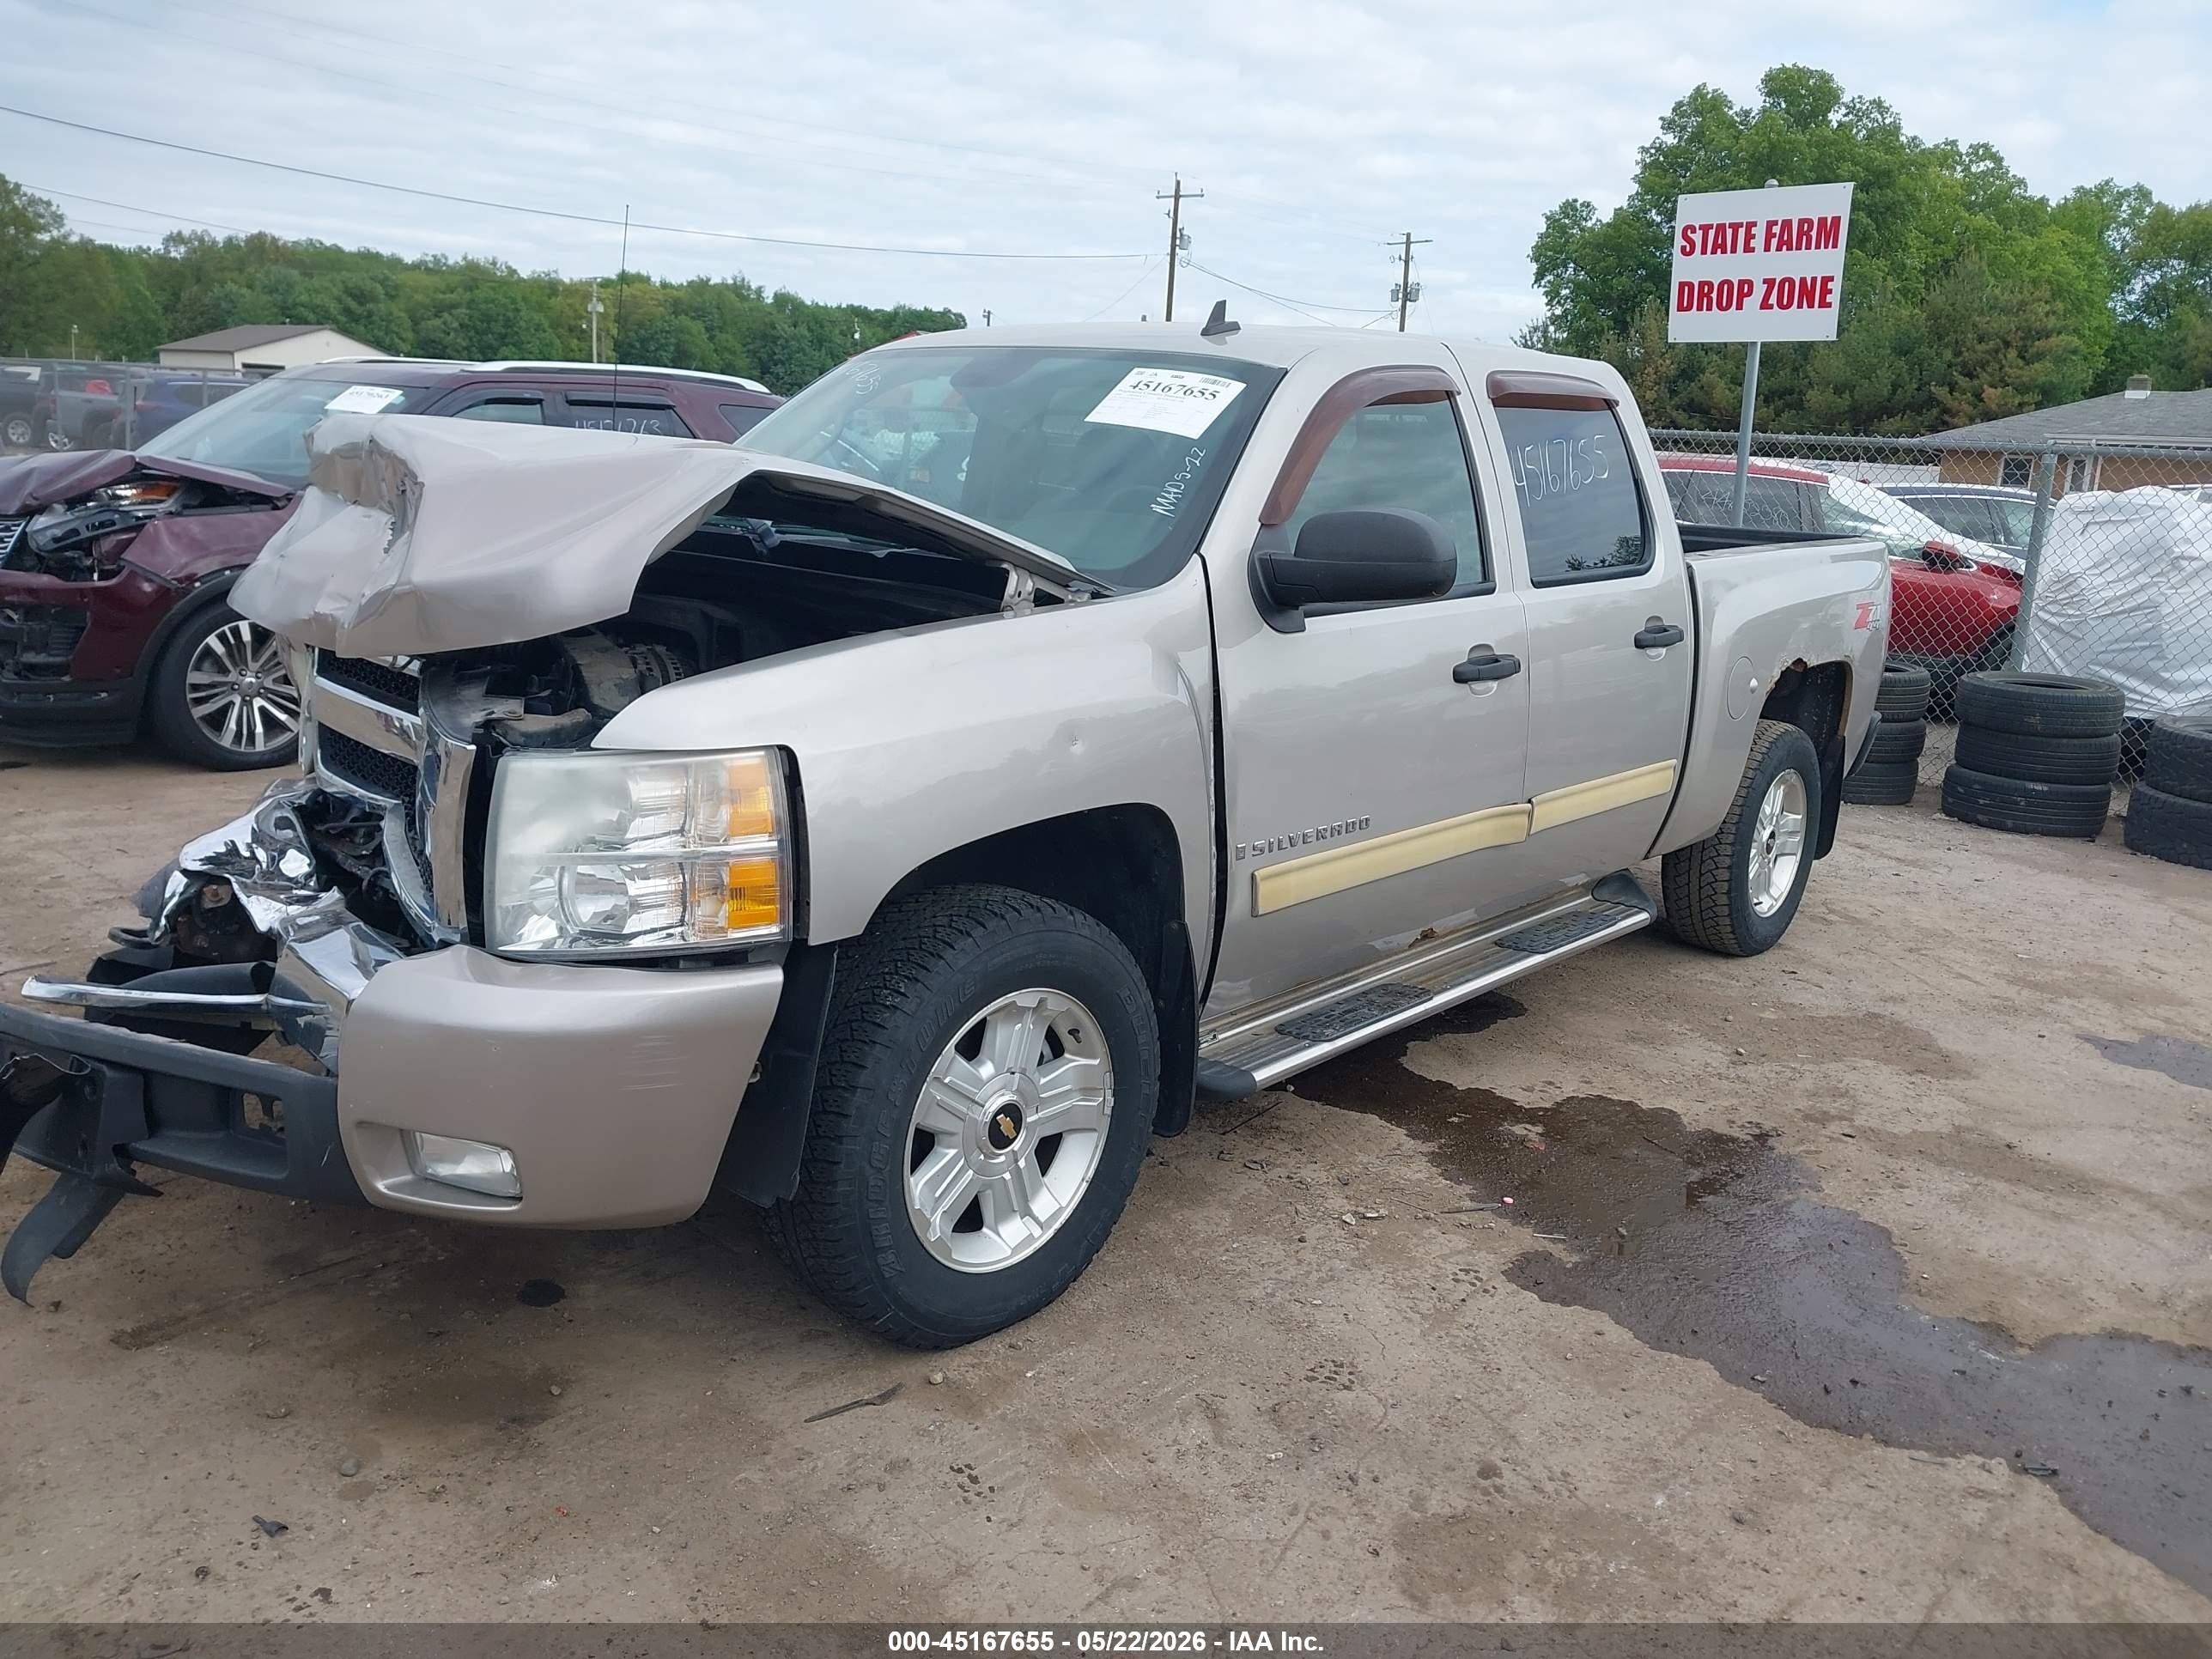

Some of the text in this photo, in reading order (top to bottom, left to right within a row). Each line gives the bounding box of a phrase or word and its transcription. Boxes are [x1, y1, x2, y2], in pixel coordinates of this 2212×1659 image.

[1680, 216, 1842, 257] STATE FARM
[1676, 275, 1835, 313] DROP ZONE
[1128, 380, 1222, 402] 45167655
[1510, 434, 1609, 507] 45167655
[1251, 815, 1371, 857] SILVERADO
